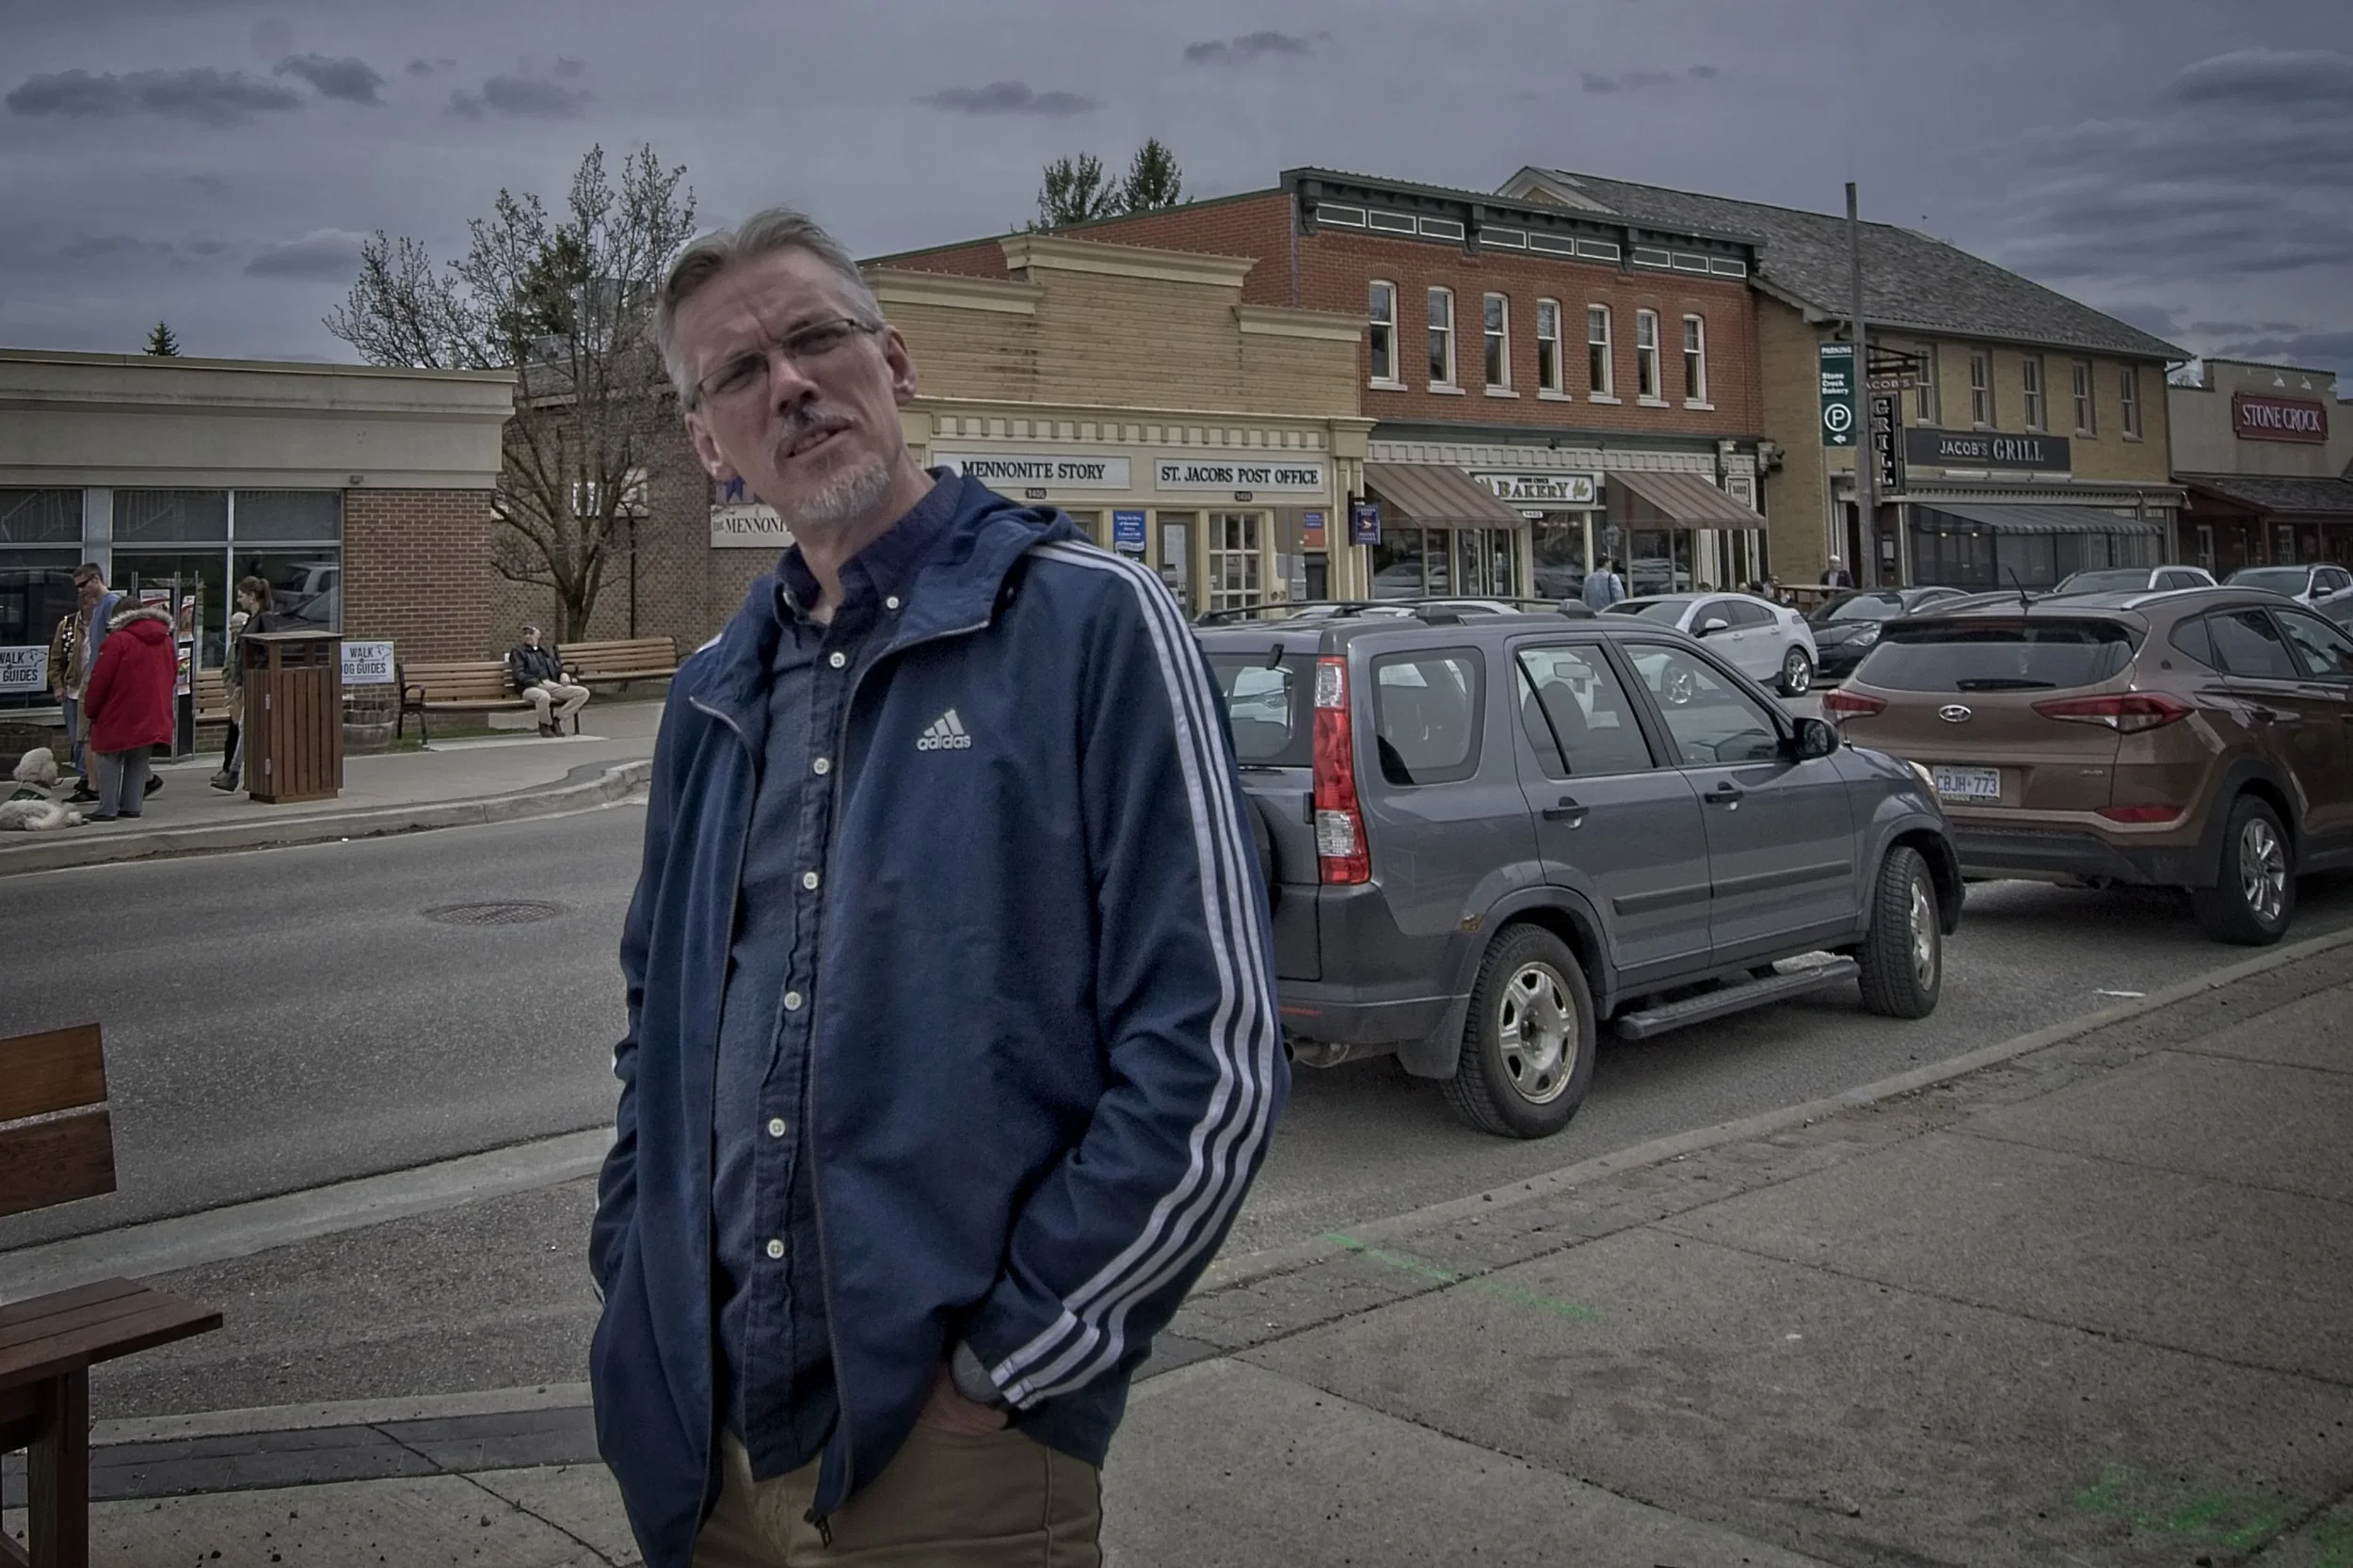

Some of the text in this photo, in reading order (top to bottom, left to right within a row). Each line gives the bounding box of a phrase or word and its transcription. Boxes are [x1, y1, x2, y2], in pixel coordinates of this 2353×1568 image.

[1821, 345, 1852, 355] PARKING
[1821, 387, 1849, 395] Bakery
[2242, 404, 2321, 433] STONE CROCK
[1873, 398, 1894, 486] GRILL
[1940, 438, 2044, 462] JACOB'S GRILL
[961, 460, 1106, 480] MENNONITE STORY
[1161, 466, 1319, 485] ST. JACOBS POST OFFICE
[1497, 481, 1570, 499] BAKERY
[726, 516, 790, 534] MENNONI
[349, 647, 375, 659] WALK
[3, 668, 38, 682] GUIDES
[344, 663, 387, 675] OG GUIDES
[917, 734, 971, 751] adidas
